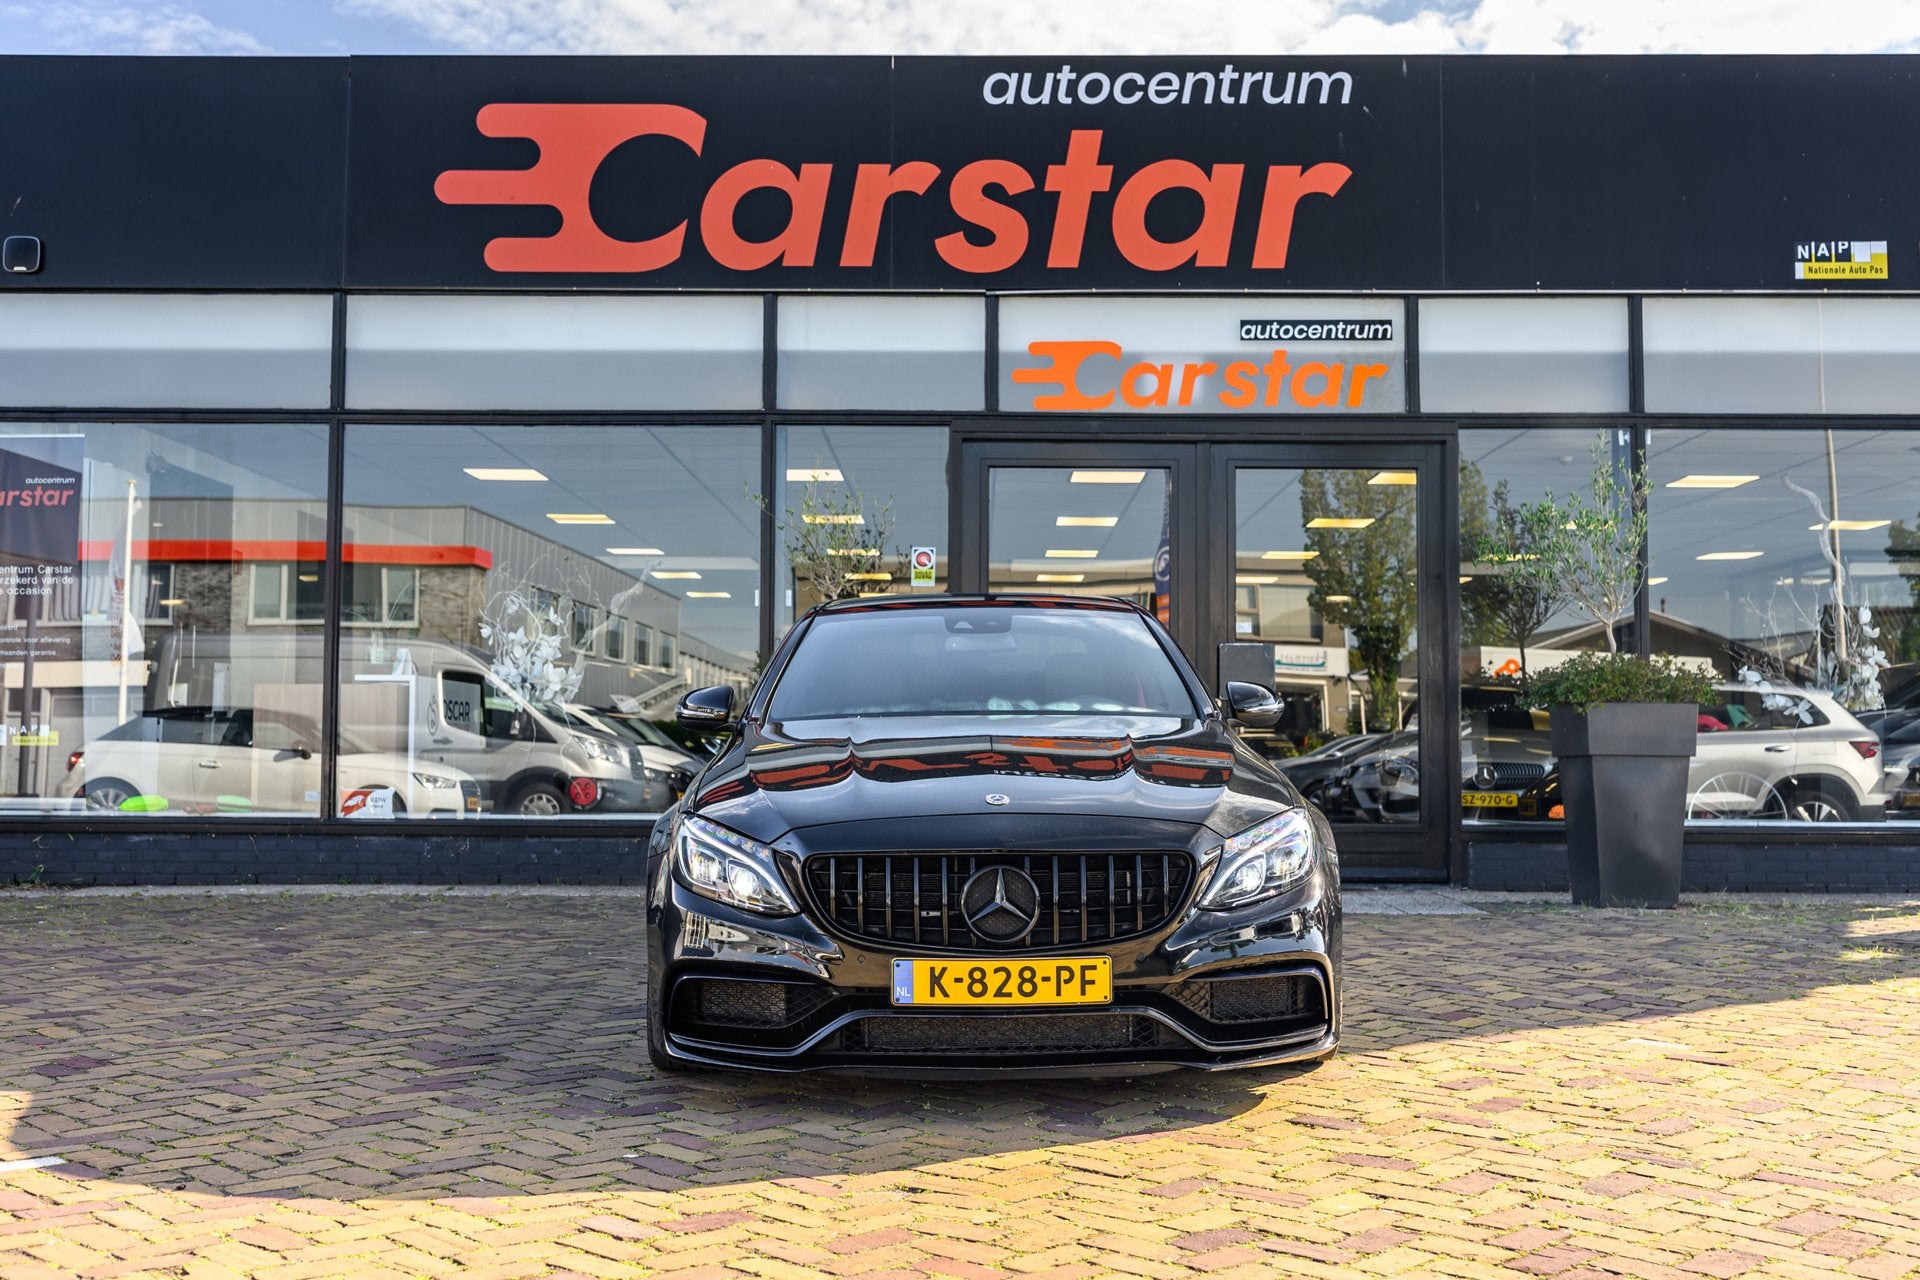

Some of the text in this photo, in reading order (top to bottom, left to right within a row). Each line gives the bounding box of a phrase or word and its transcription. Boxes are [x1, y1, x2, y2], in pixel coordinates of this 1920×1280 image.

[982, 64, 1353, 106] autocentrum
[433, 103, 1354, 274] Carstar
[1808, 265, 1884, 275] Nationale Auto Pas
[1240, 320, 1393, 341] autocentrum
[1011, 340, 1389, 411] Carstar
[25, 476, 76, 485] autocentrum
[37, 564, 73, 575] Carstar
[41, 577, 59, 585] van
[61, 575, 74, 585] de
[6, 586, 53, 596] occasion
[1461, 794, 1513, 806] SZ-970-G
[929, 965, 1098, 998] K-828-PF
[896, 986, 911, 997] NL
